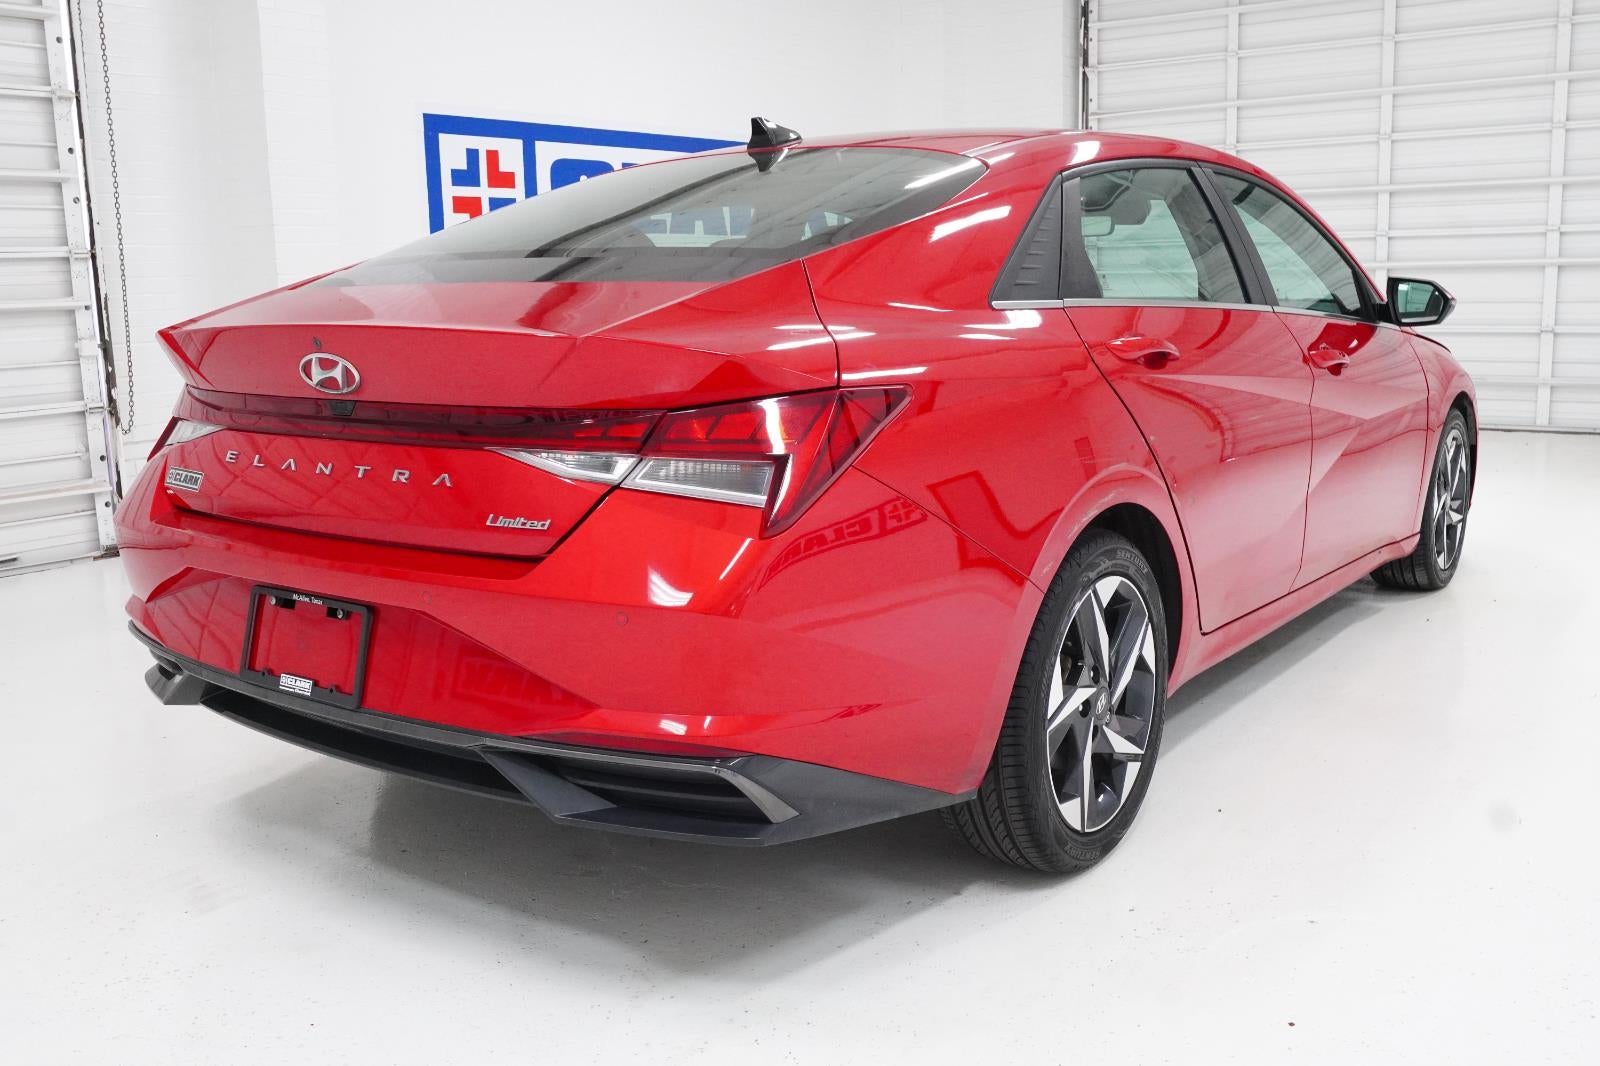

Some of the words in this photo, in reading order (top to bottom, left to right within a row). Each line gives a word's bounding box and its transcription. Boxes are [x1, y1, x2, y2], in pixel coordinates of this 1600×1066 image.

[225, 449, 453, 488] ELANTRA
[173, 471, 201, 487] CLARK
[485, 513, 552, 531] Limited
[287, 676, 311, 690] CLARK
